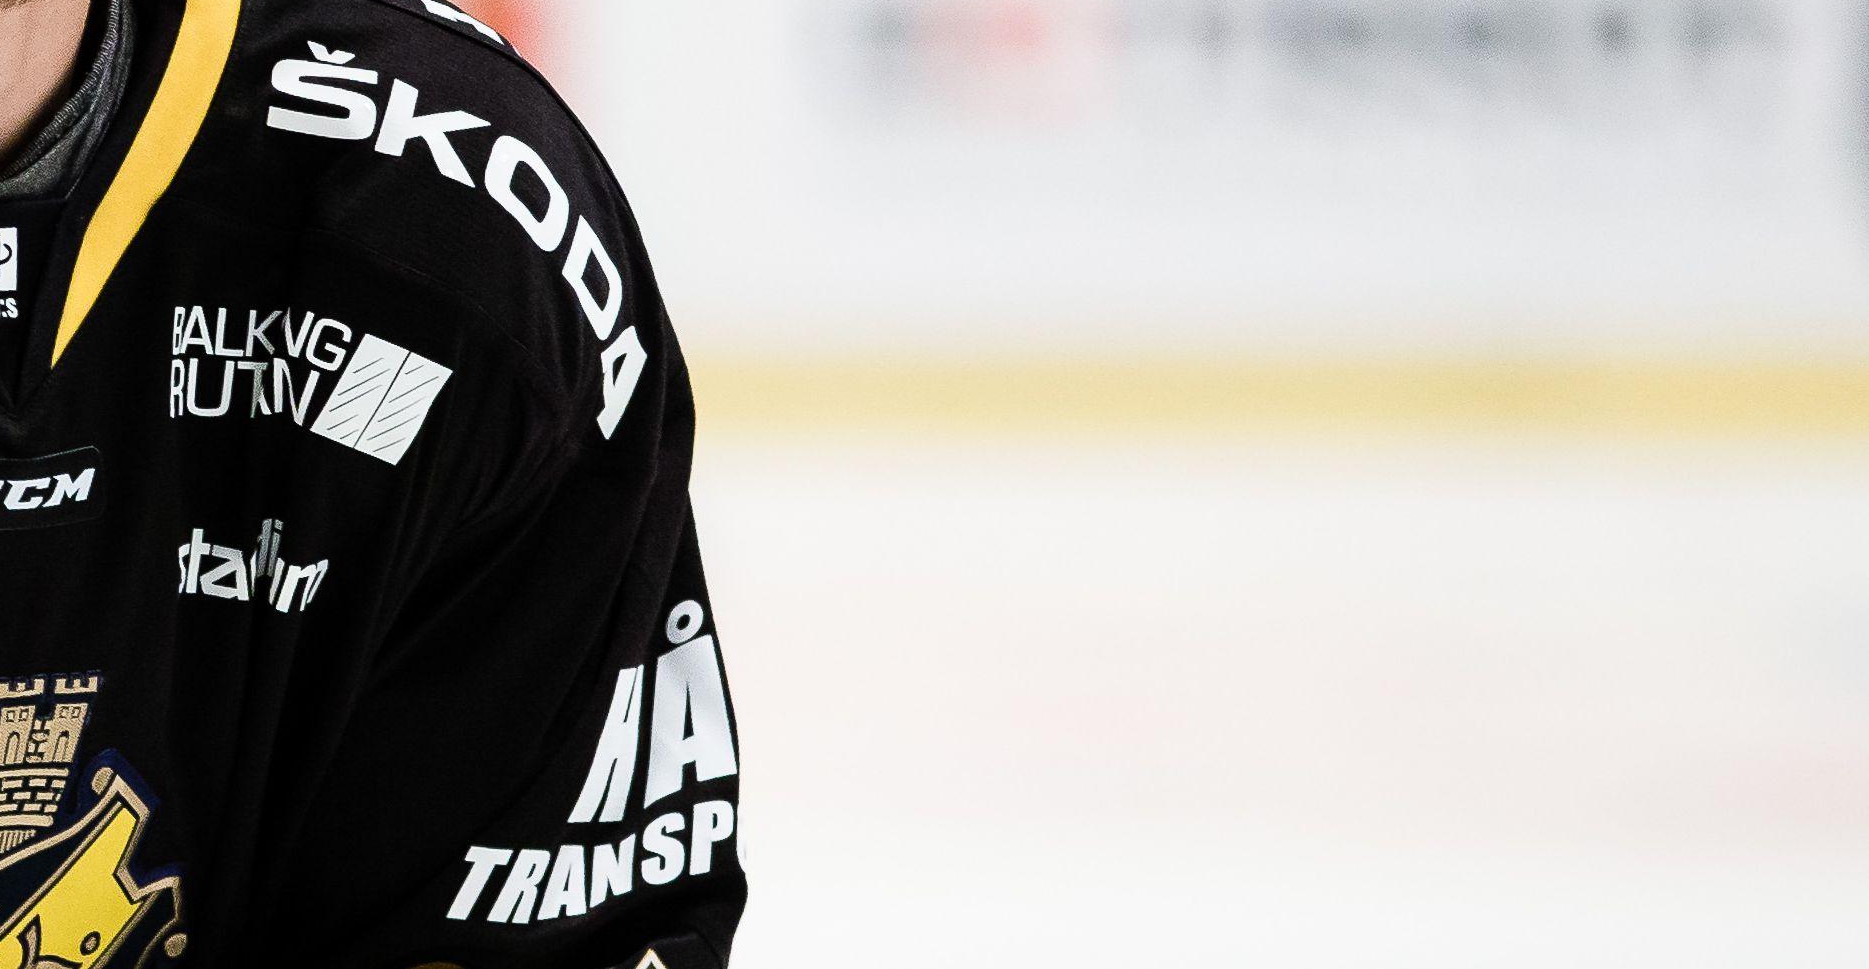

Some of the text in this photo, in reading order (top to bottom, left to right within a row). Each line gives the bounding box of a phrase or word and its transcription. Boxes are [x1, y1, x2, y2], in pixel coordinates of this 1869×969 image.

[266, 40, 648, 440] ŠKODA
[172, 305, 353, 372] BALKNG
[445, 798, 737, 925] TRANSP
